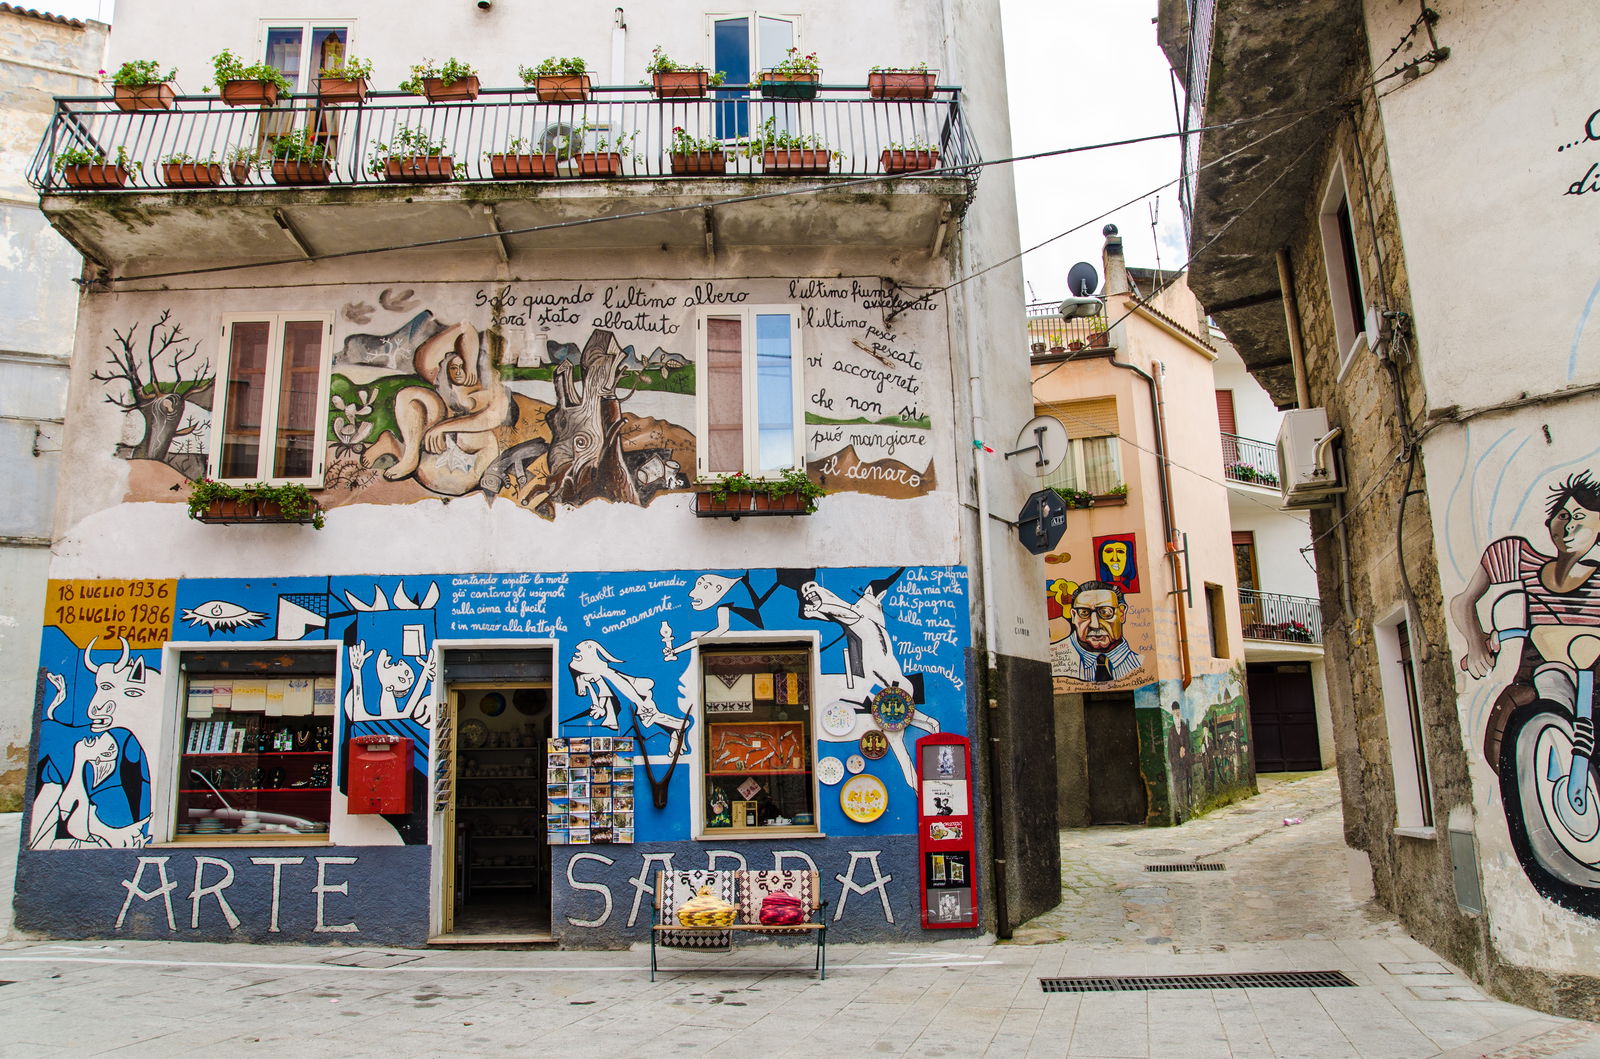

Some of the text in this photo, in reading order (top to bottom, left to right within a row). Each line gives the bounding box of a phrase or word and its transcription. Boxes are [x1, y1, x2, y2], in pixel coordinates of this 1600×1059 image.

[475, 282, 750, 319] Solo quando l'ultimo albero
[788, 280, 894, 302] l'ultimo fiume
[537, 307, 581, 326] stato
[592, 311, 680, 334] abbattuto
[806, 306, 897, 343] l'ultimo pesce
[871, 342, 922, 370] pescato
[807, 353, 919, 395] vi accorgerete
[811, 388, 834, 410] che
[846, 397, 882, 415] non
[850, 431, 927, 456] mangiare
[819, 456, 921, 488] il denaro
[452, 572, 569, 588] cantando aspetto la morte
[896, 581, 963, 595] della mia vita
[929, 570, 969, 586] Spagna
[58, 581, 169, 601] 18 LUGLIO 1936
[470, 585, 510, 599] cantano
[512, 586, 526, 604] gli
[529, 584, 565, 604] usignoli
[578, 574, 687, 608] travolti senza rimedio
[56, 606, 76, 625] 18
[130, 603, 170, 625] 1986
[451, 600, 546, 618] sulla cima dei fucili
[583, 605, 627, 627] gridiamo
[910, 598, 956, 615] Spagna
[457, 620, 469, 630] in
[502, 618, 523, 632] alla
[524, 616, 568, 638] battaglia
[898, 609, 956, 628] della mia
[103, 625, 169, 644] SPAGNA
[923, 628, 958, 646] morte
[904, 658, 964, 691] Hernandez
[114, 856, 360, 932] ARTE
